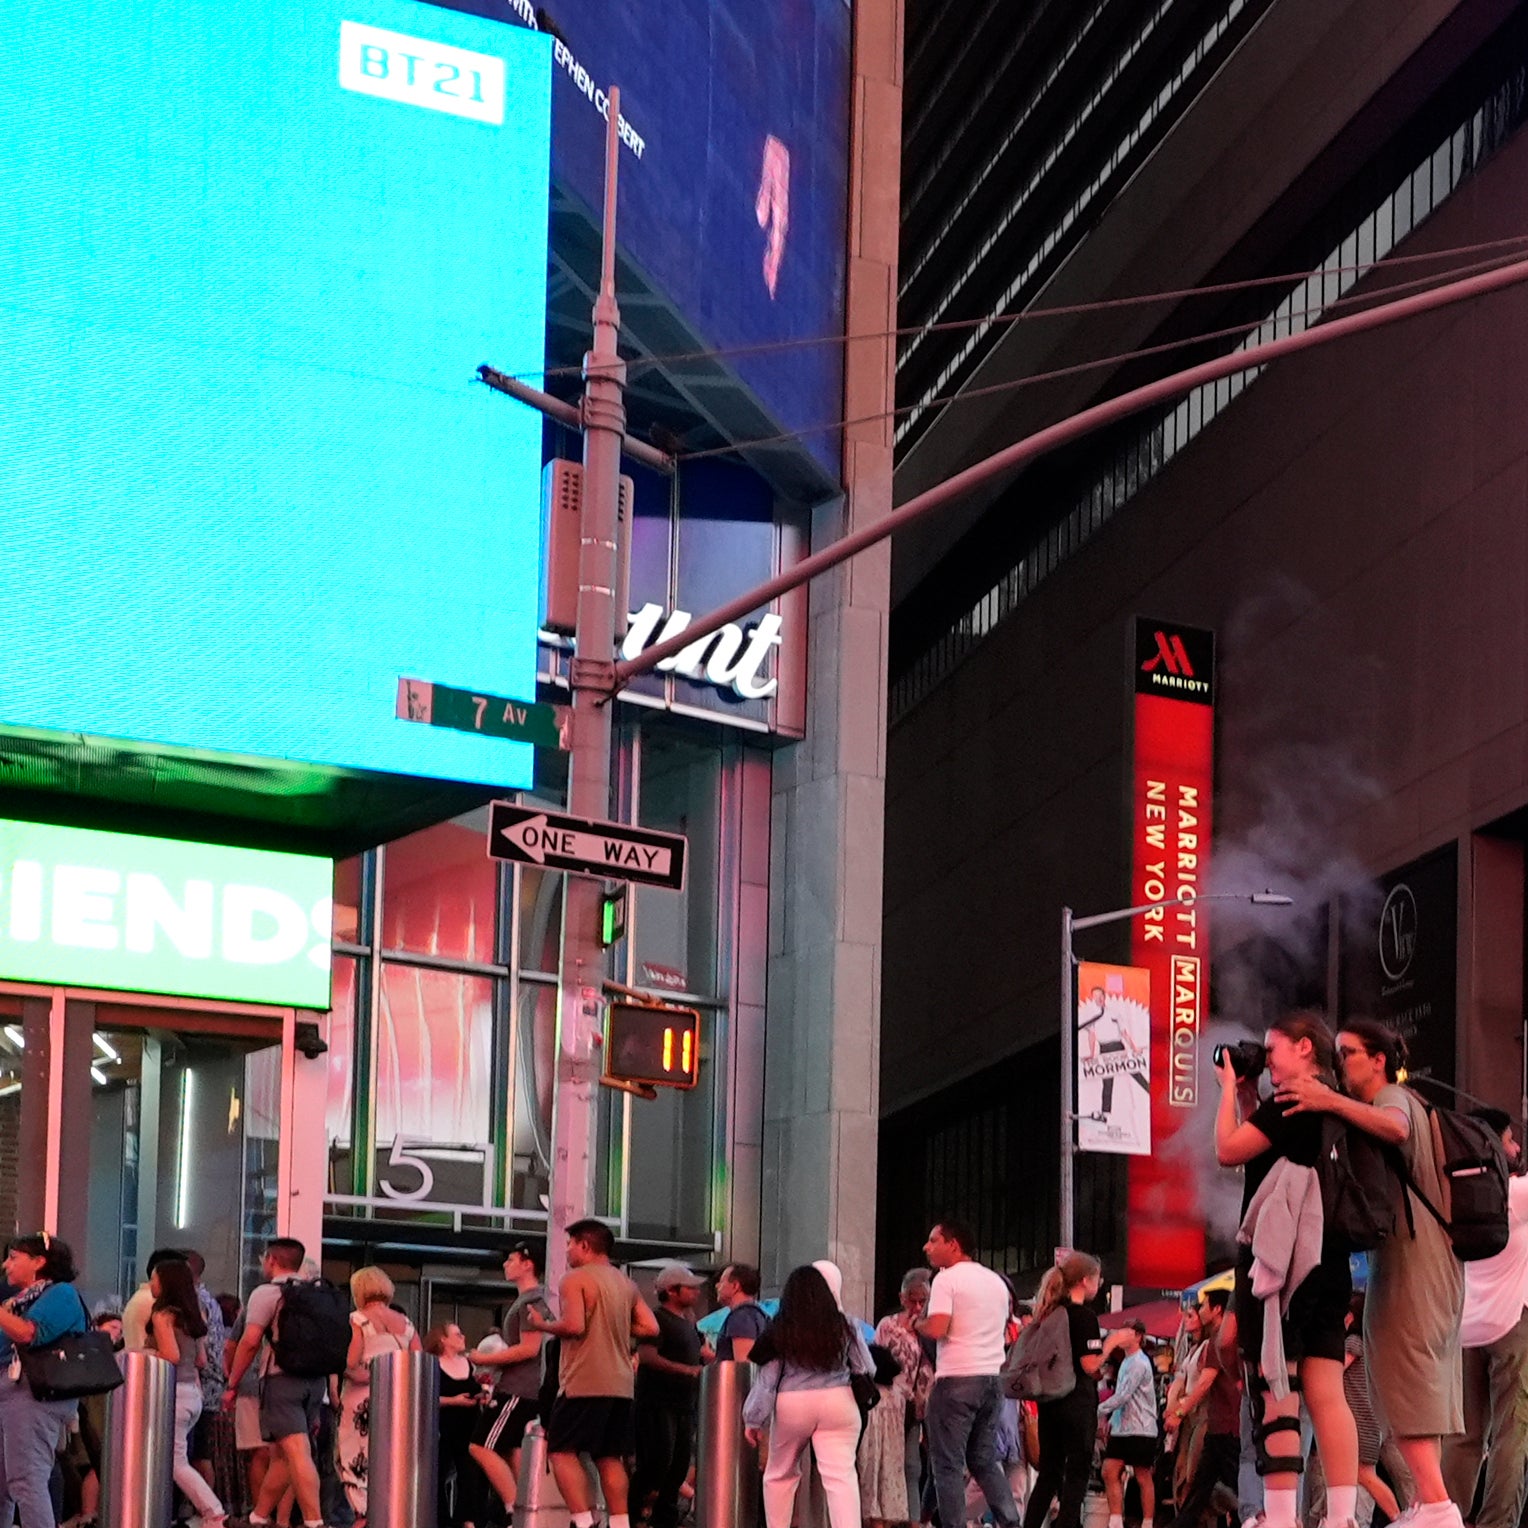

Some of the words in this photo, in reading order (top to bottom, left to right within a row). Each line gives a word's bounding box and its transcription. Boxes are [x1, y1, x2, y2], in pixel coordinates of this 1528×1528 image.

[360, 43, 485, 103] BT21
[553, 37, 595, 102] EPHEN
[595, 88, 646, 160] COBERT
[471, 696, 486, 729] 7
[502, 704, 527, 726] Av
[1152, 673, 1209, 694] MARRIOTT
[1145, 779, 1166, 851] NEW
[521, 825, 577, 856] ONE
[602, 839, 661, 870] WAY
[1175, 785, 1198, 950] MARRIOTT
[1144, 861, 1166, 943] YORK
[661, 1026, 694, 1075] 11
[1174, 961, 1196, 1102] MARQUIS
[1082, 1057, 1147, 1079] MORMON
